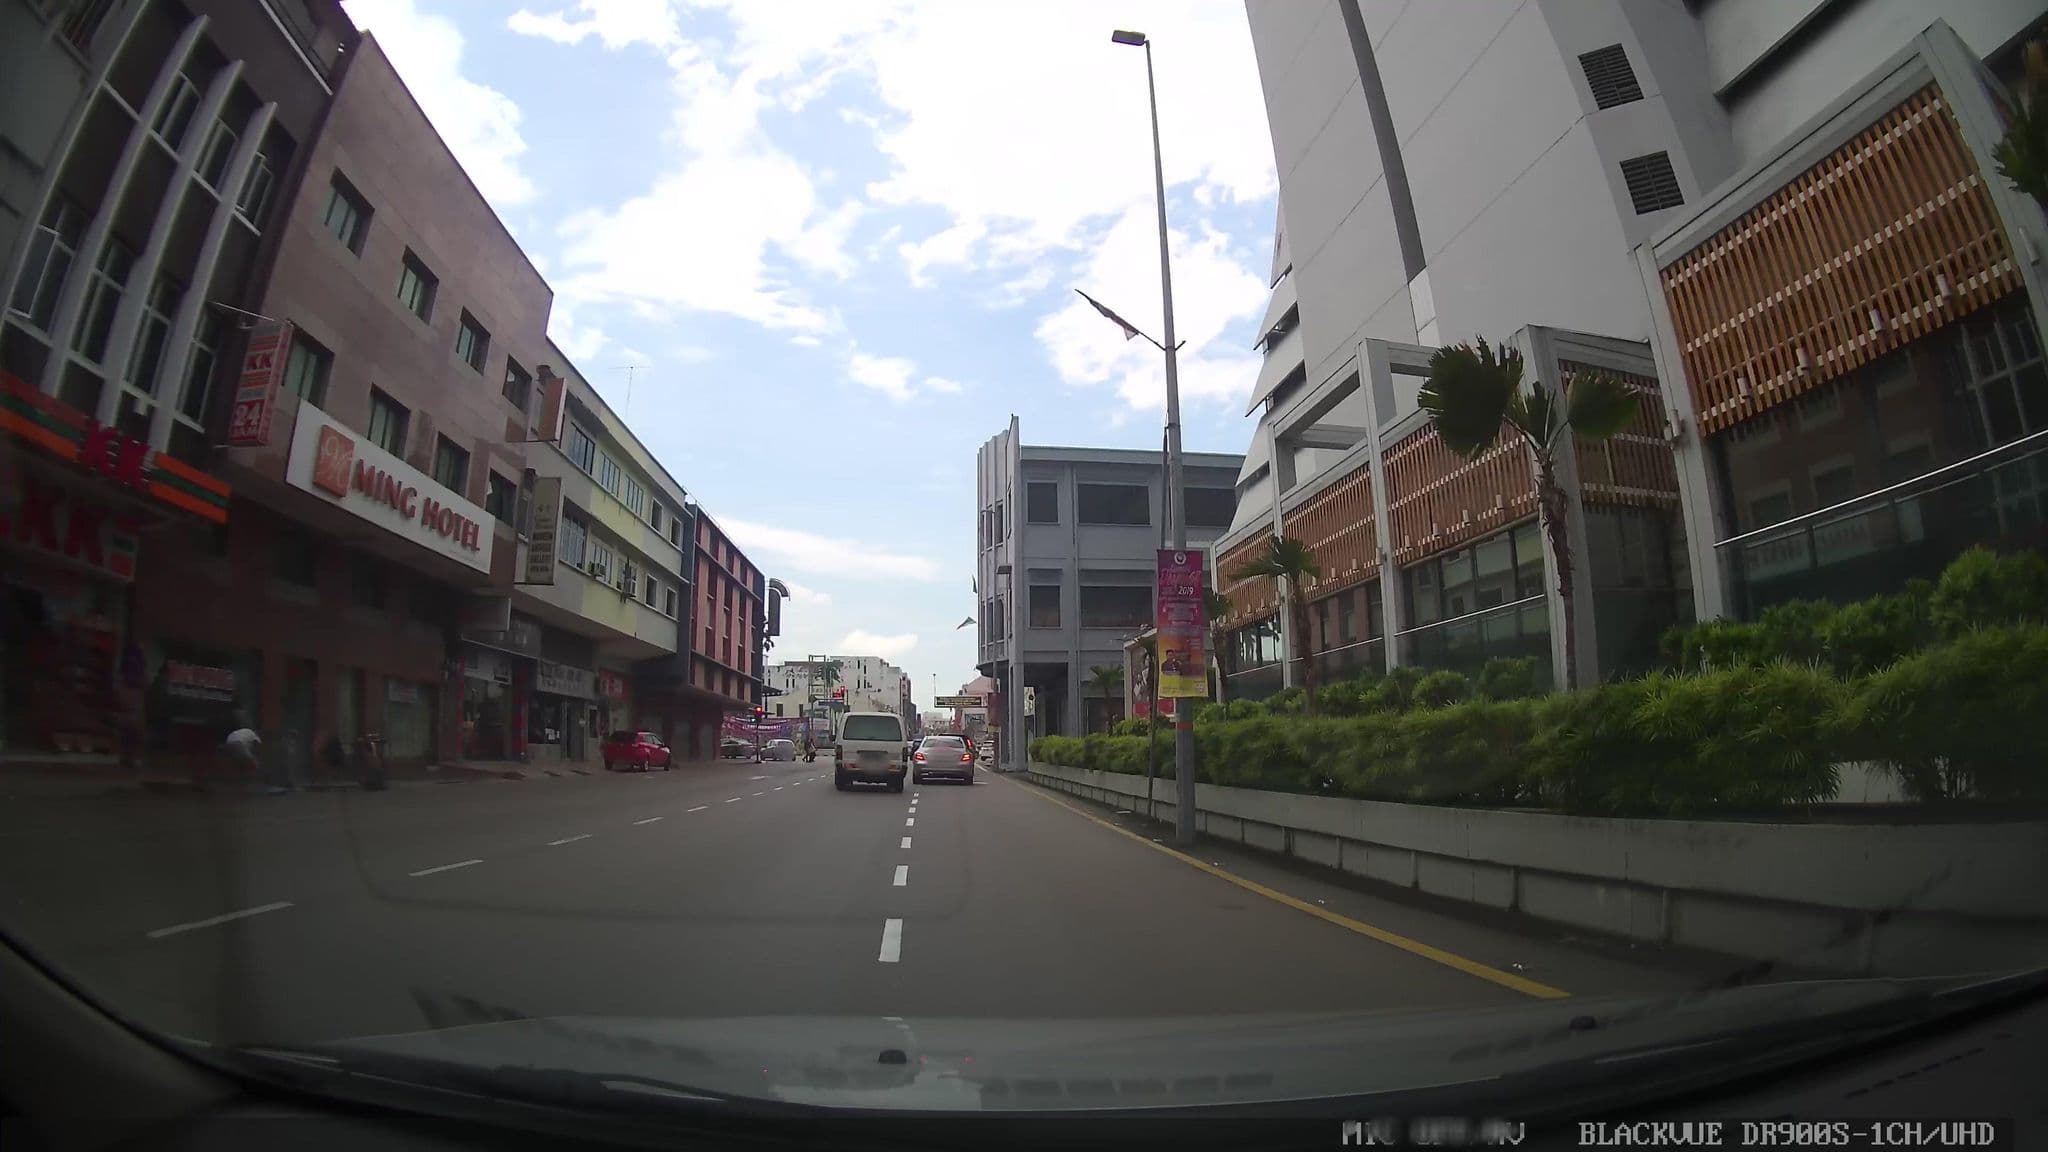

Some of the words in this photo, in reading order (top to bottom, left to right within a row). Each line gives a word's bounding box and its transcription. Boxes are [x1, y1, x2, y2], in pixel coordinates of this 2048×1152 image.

[246, 350, 273, 370] KK
[232, 402, 260, 426] 24
[81, 419, 151, 495] KK
[17, 478, 109, 567] KK
[353, 459, 418, 519] MING
[422, 497, 480, 552] HOTEL
[1177, 585, 1195, 598] 2019
